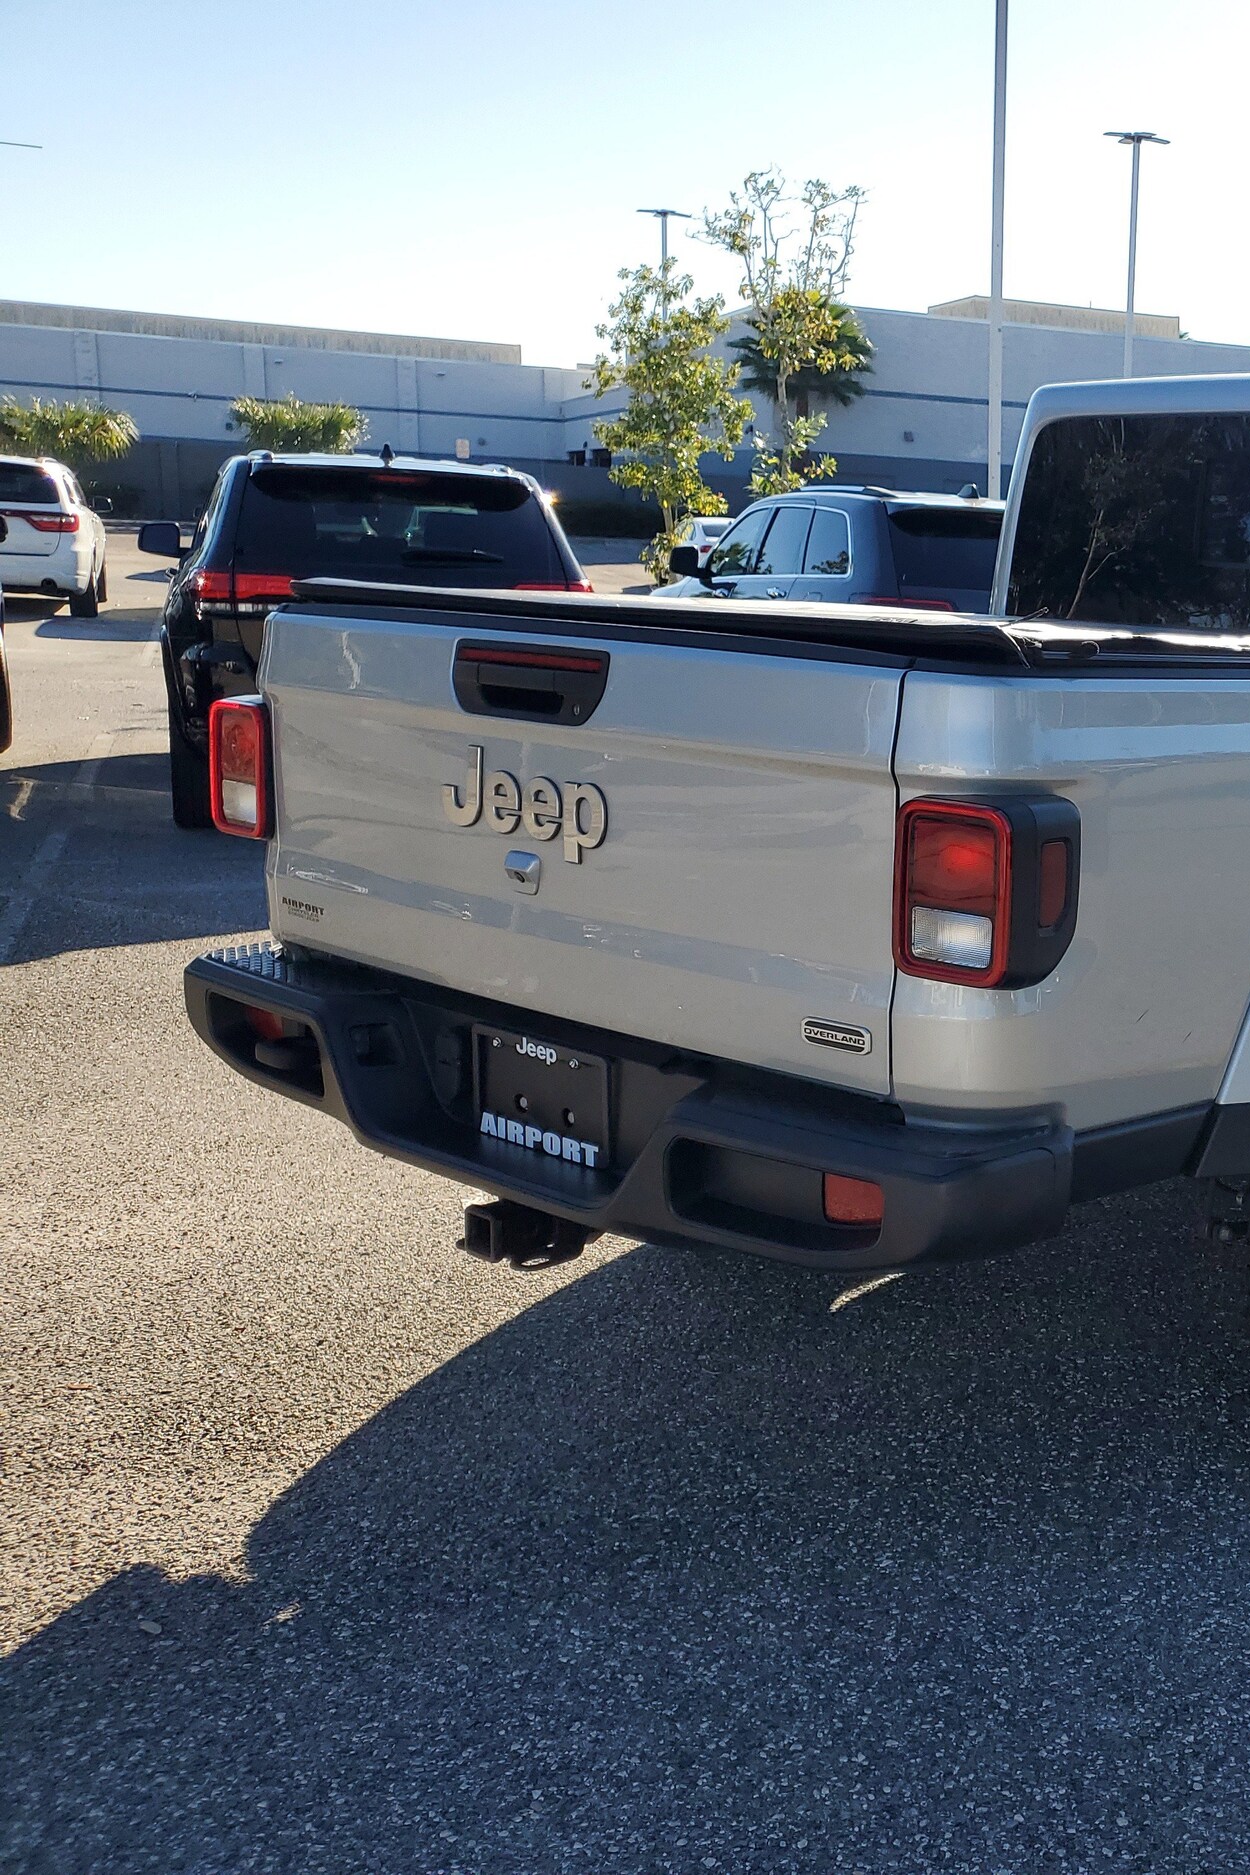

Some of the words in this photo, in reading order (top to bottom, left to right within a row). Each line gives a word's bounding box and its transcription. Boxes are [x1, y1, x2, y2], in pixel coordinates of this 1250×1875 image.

[442, 744, 608, 864] Jeep
[282, 897, 324, 915] AIRPORT
[804, 1027, 865, 1046] OVERLAND
[516, 1037, 557, 1065] Jeep
[480, 1112, 599, 1167] AIRPORT
